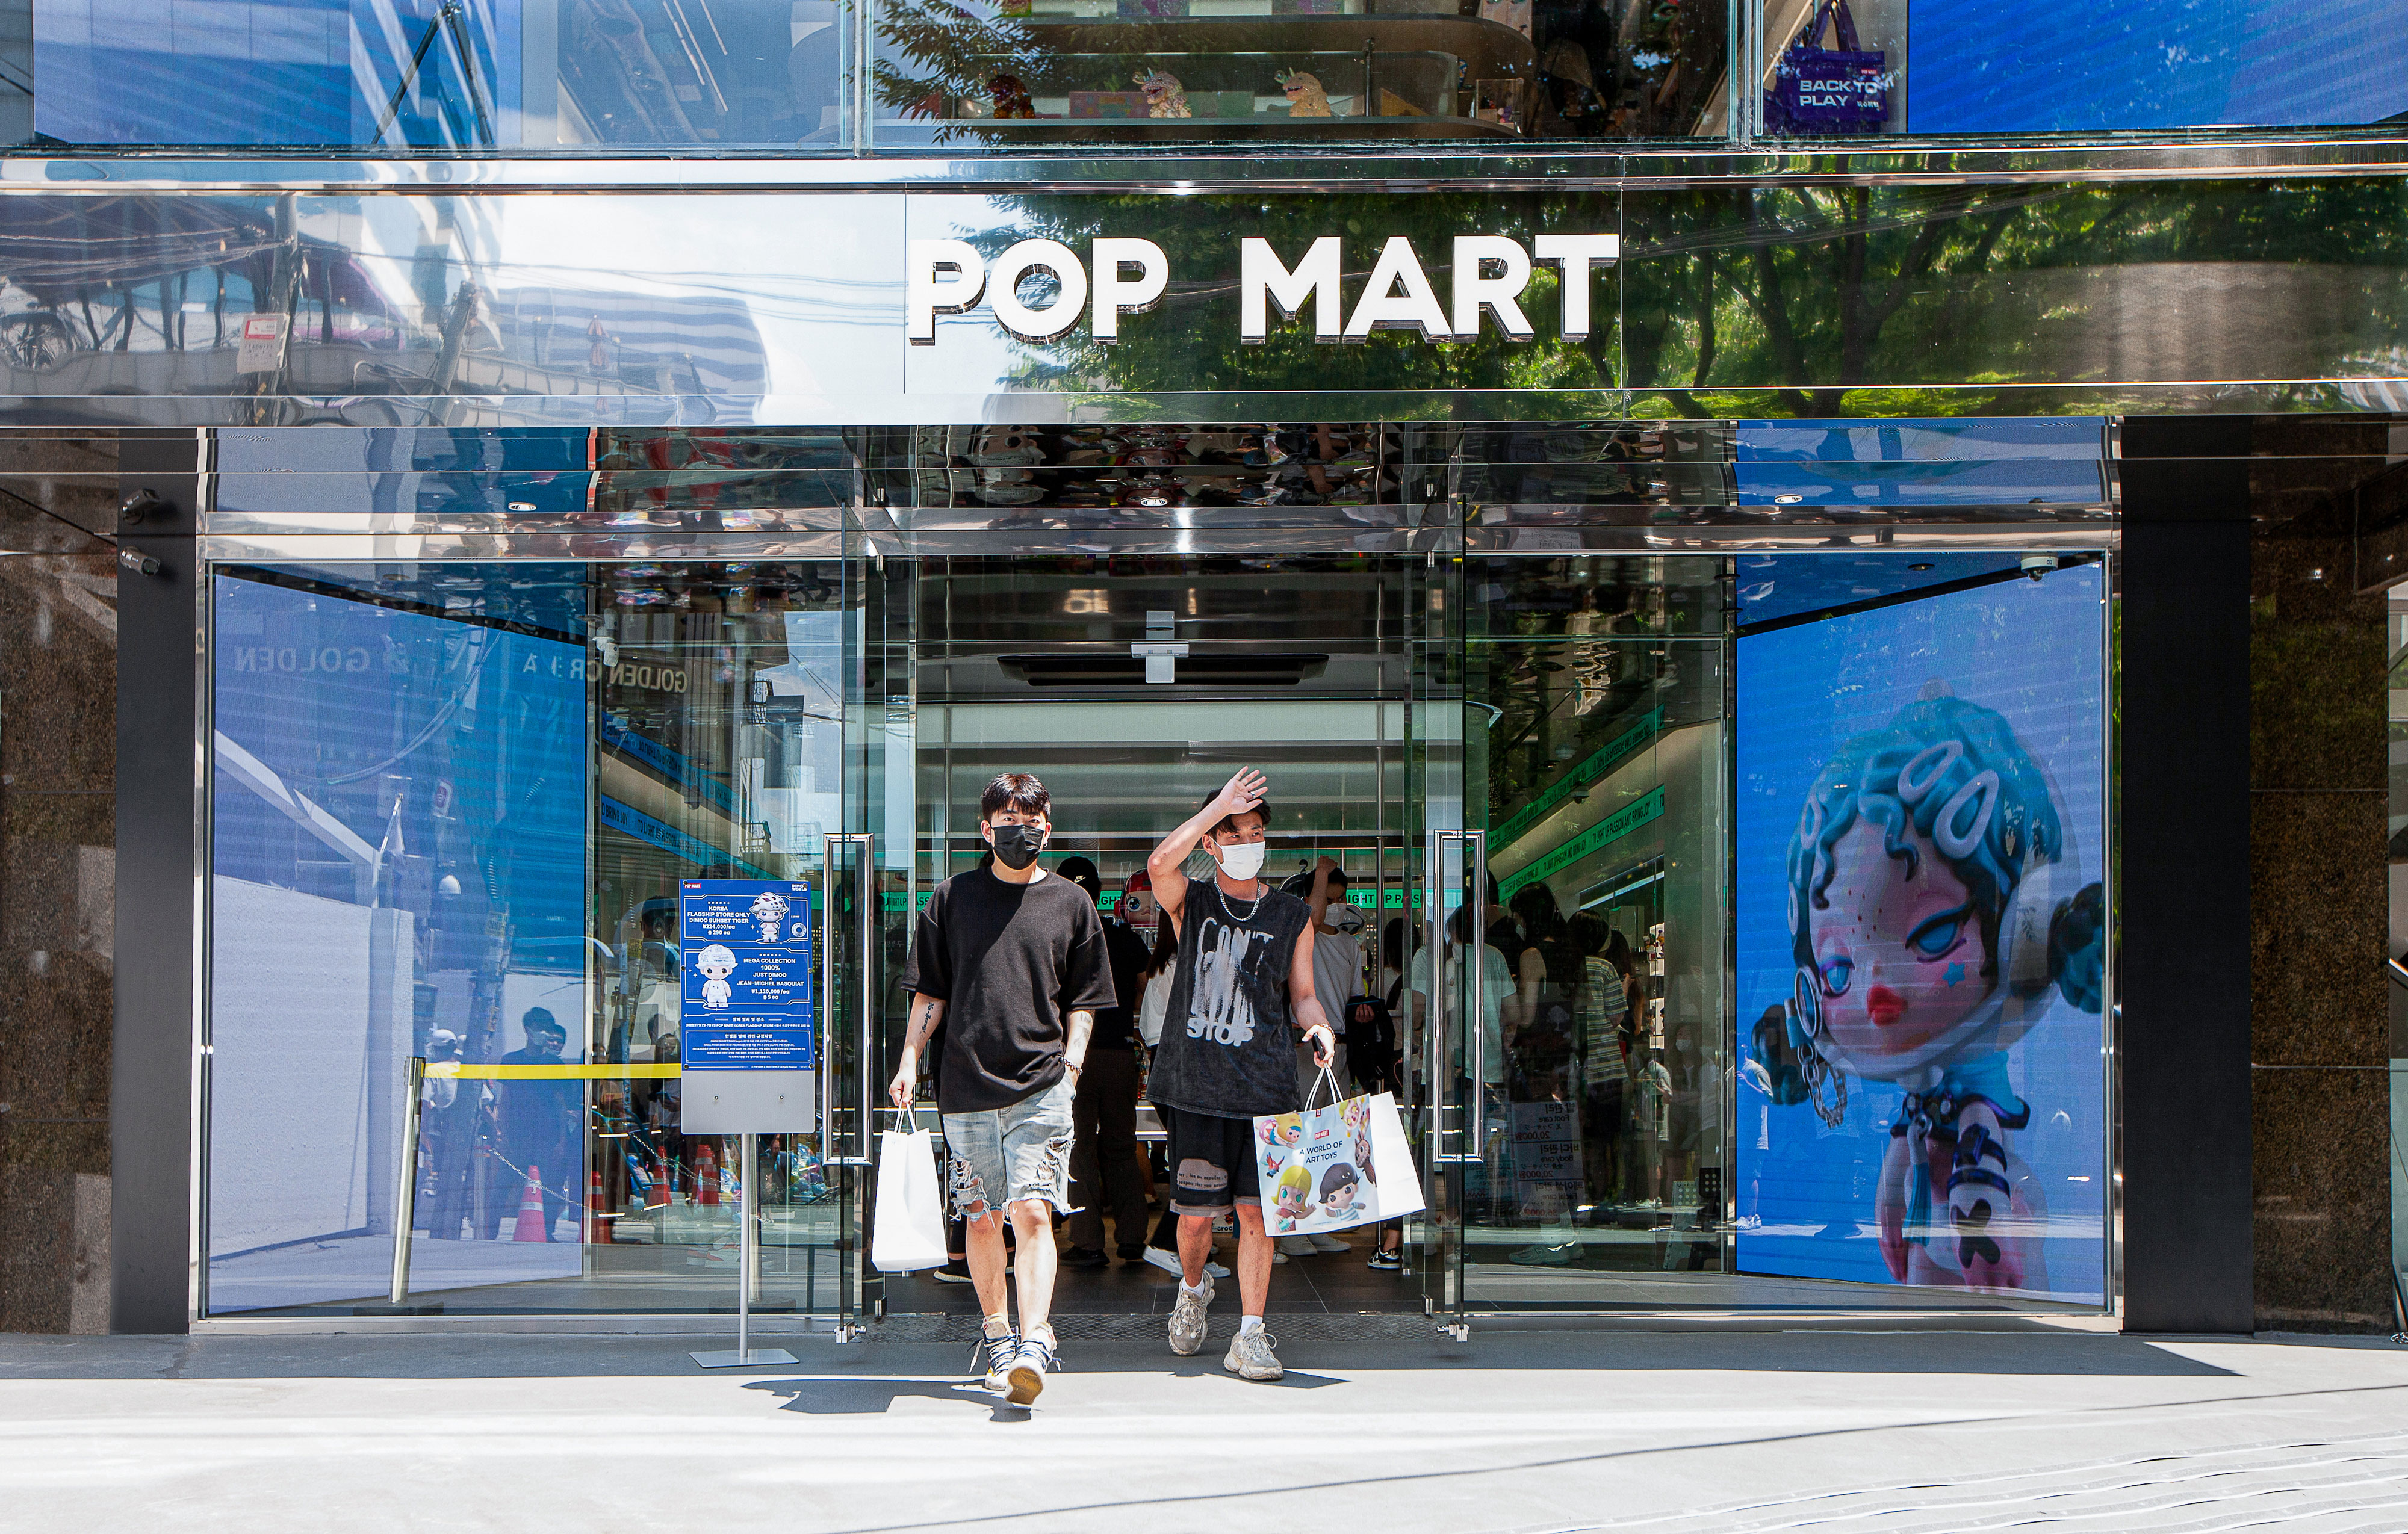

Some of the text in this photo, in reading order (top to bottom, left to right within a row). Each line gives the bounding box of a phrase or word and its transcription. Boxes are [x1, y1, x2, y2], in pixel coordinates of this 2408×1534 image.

[1800, 80, 1878, 94] BACK TO
[1799, 95, 1848, 106] PLAY
[908, 234, 1620, 347] POP MART
[606, 806, 619, 822] BRING
[638, 819, 643, 833] TO
[644, 823, 656, 838] LIGHT
[1187, 1015, 1256, 1047] STOP
[1306, 1143, 1332, 1154] WORLD
[1305, 1151, 1338, 1164] ART TOYS
